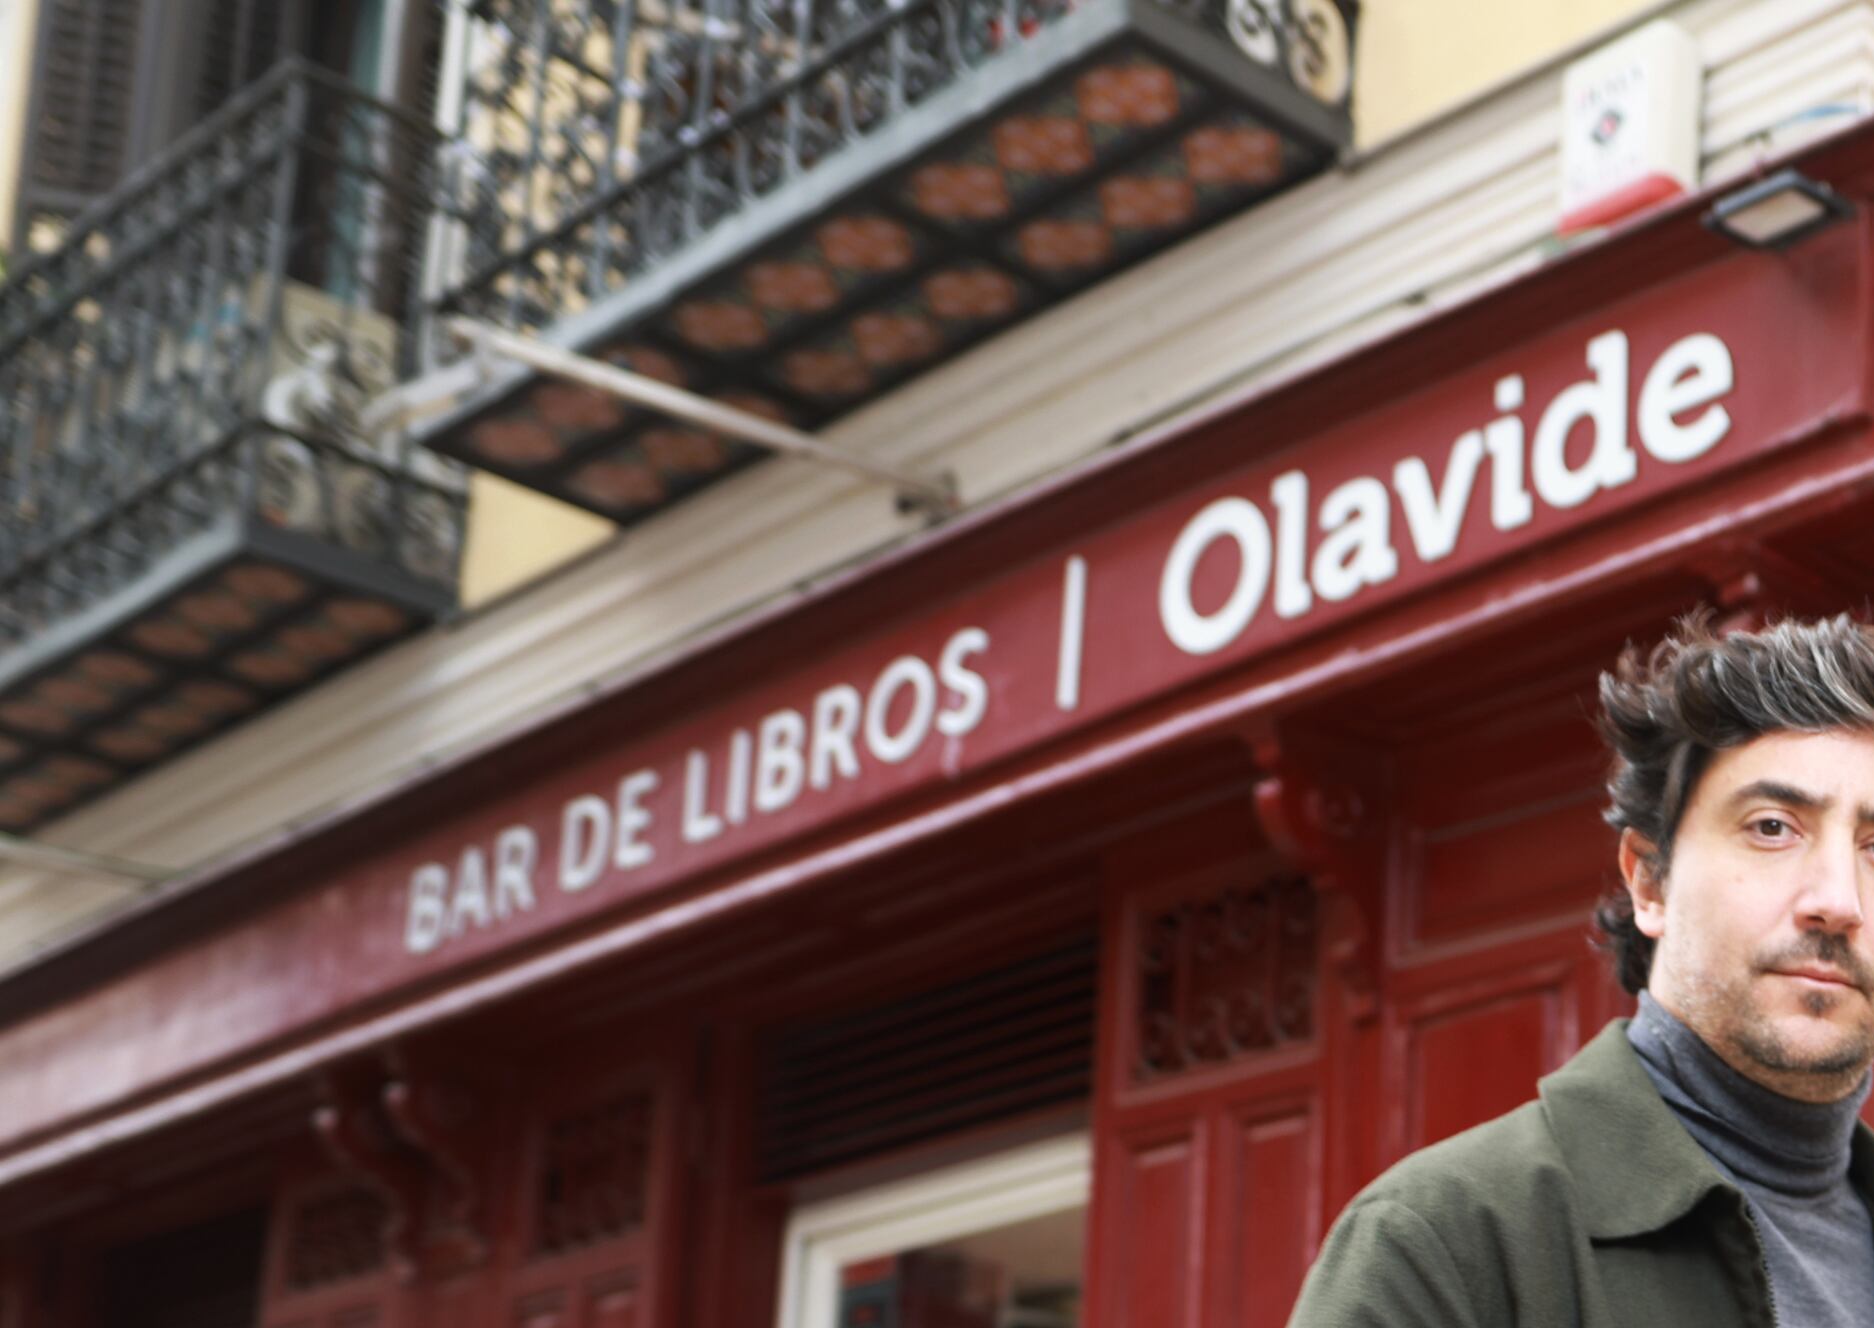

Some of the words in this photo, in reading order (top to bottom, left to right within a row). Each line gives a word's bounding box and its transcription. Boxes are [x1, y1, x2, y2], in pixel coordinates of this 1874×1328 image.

[405, 827, 537, 953] BAR
[558, 769, 658, 892] DE
[682, 627, 989, 843] LIBROS
[1158, 329, 1735, 656] Olavide
